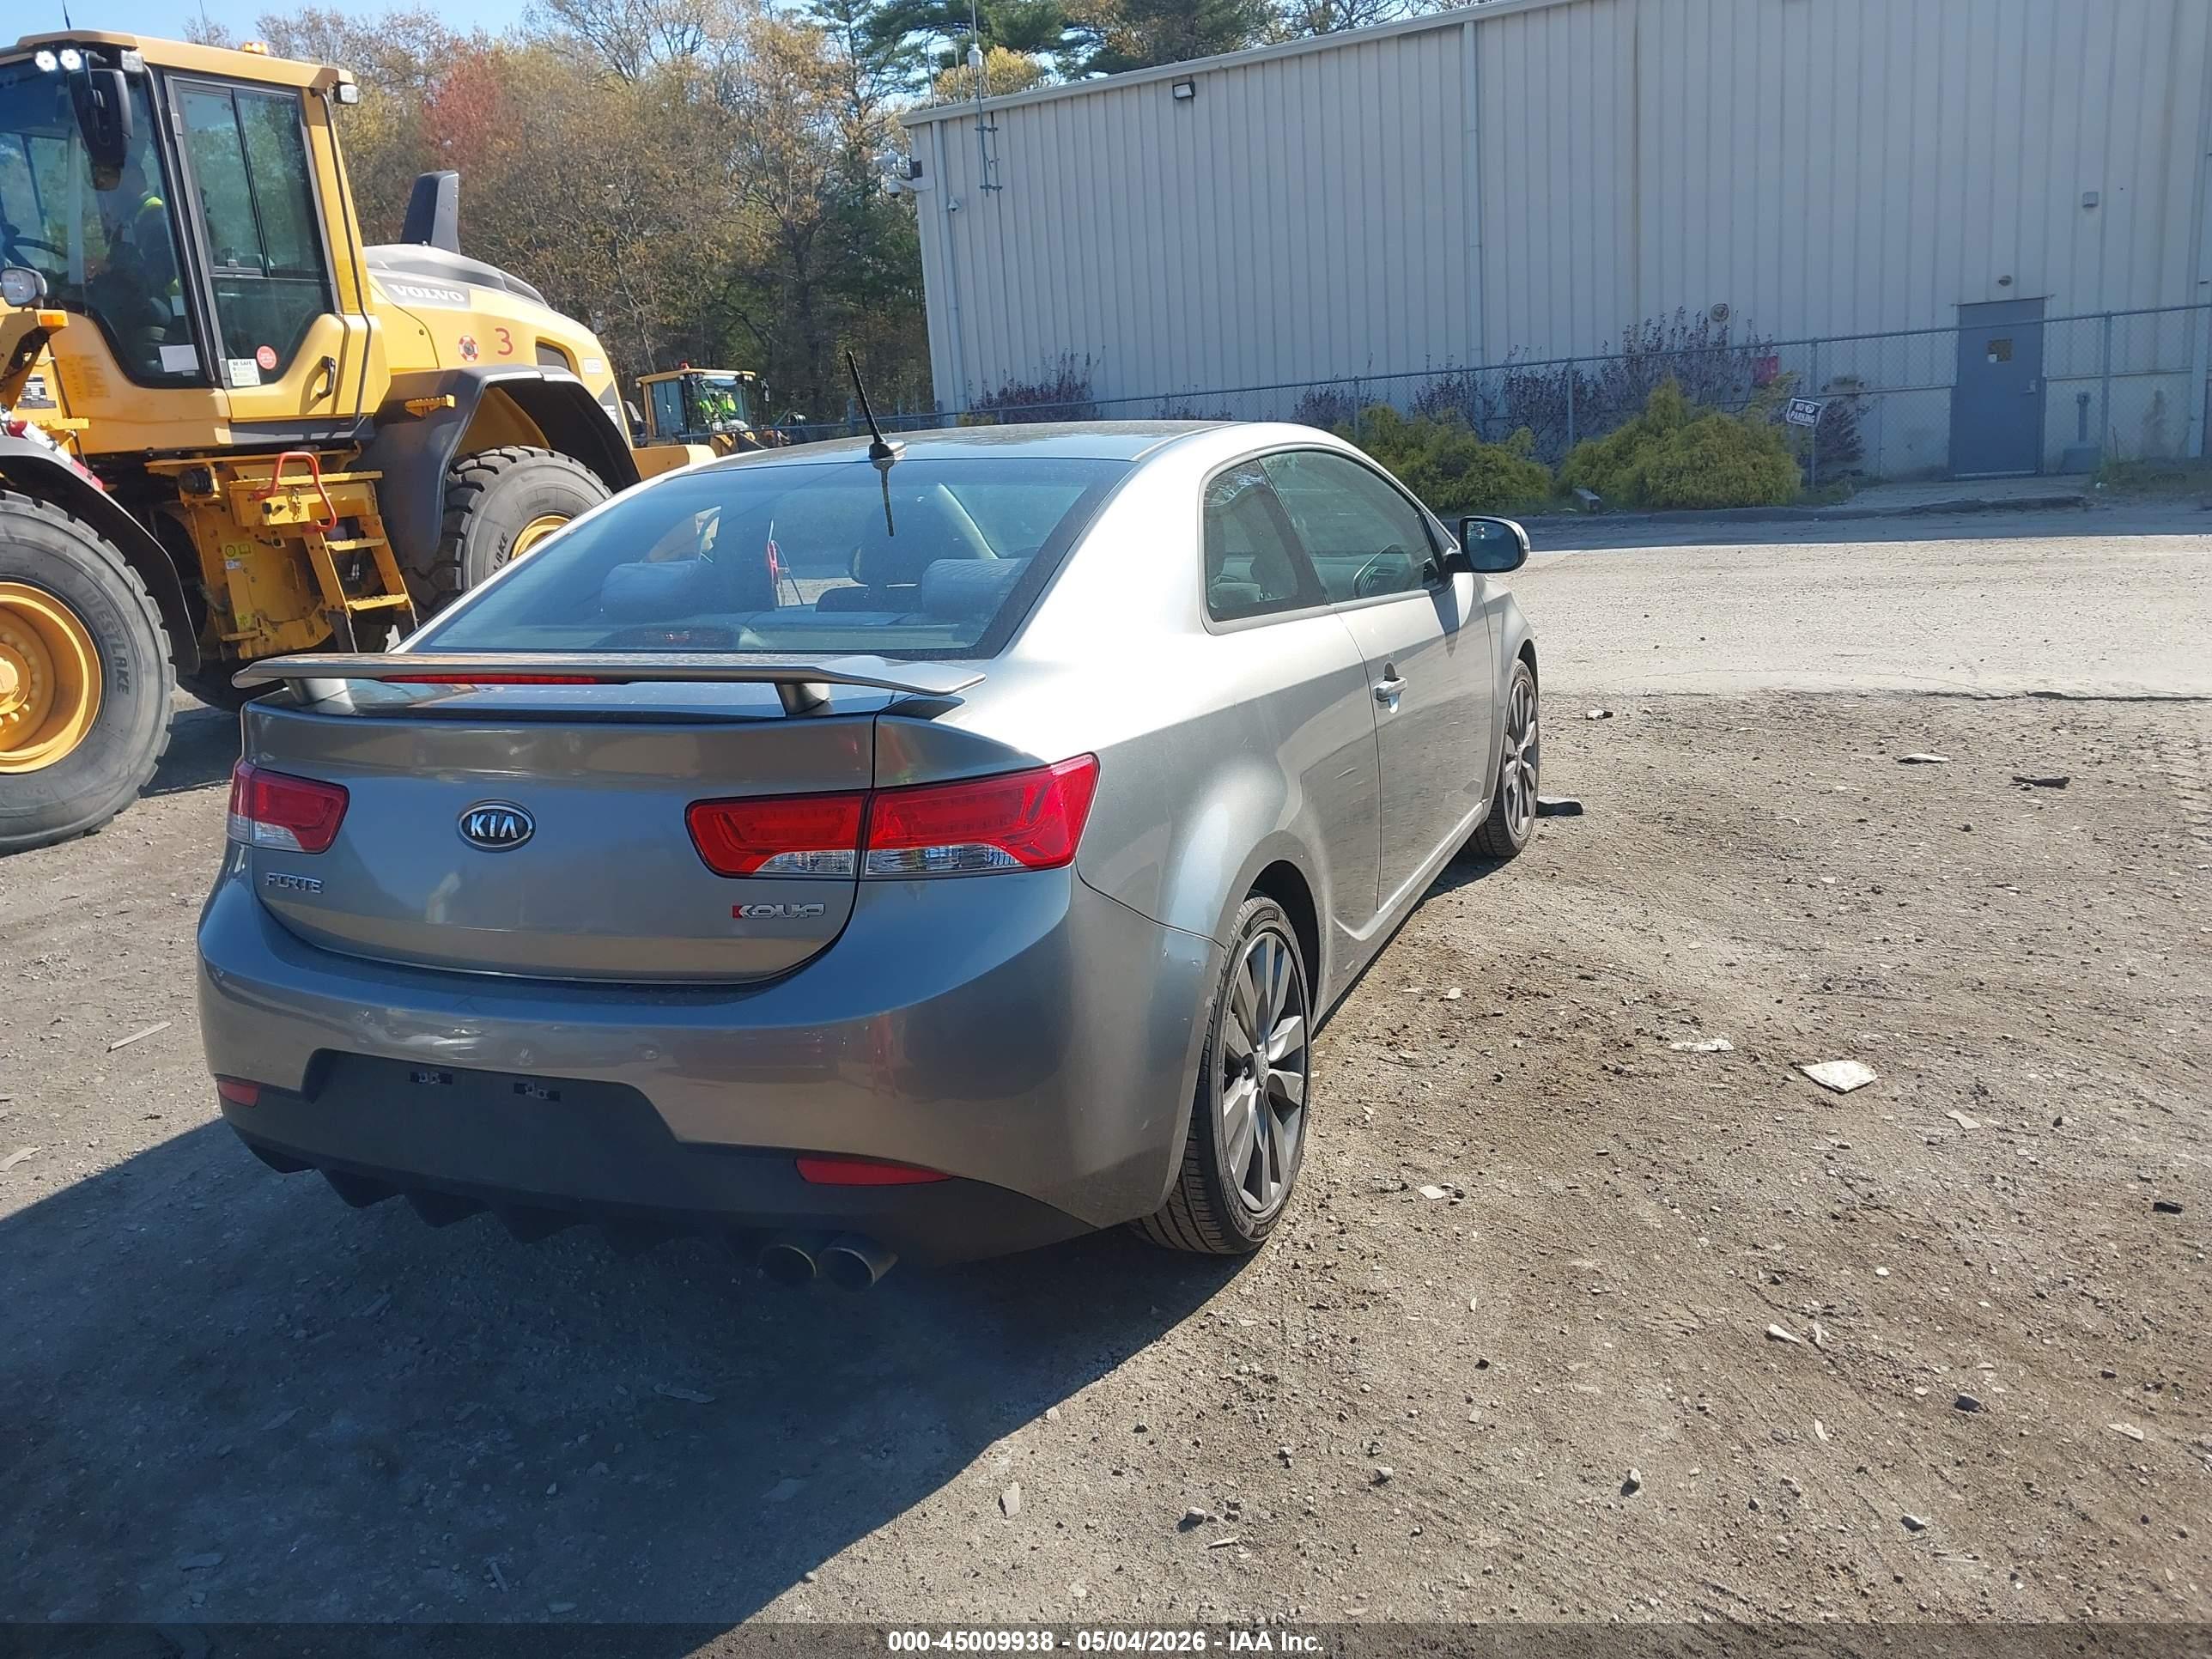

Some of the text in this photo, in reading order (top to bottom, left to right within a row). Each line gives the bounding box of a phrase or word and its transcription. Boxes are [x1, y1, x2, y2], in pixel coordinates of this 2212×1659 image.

[388, 283, 465, 302] VOLVO
[494, 327, 514, 356] 3
[1790, 410, 1815, 423] PARKING
[1795, 402, 1804, 411] NO
[78, 587, 131, 695] WESTLAKE
[470, 813, 519, 839] KIA
[264, 872, 323, 894] FORTE
